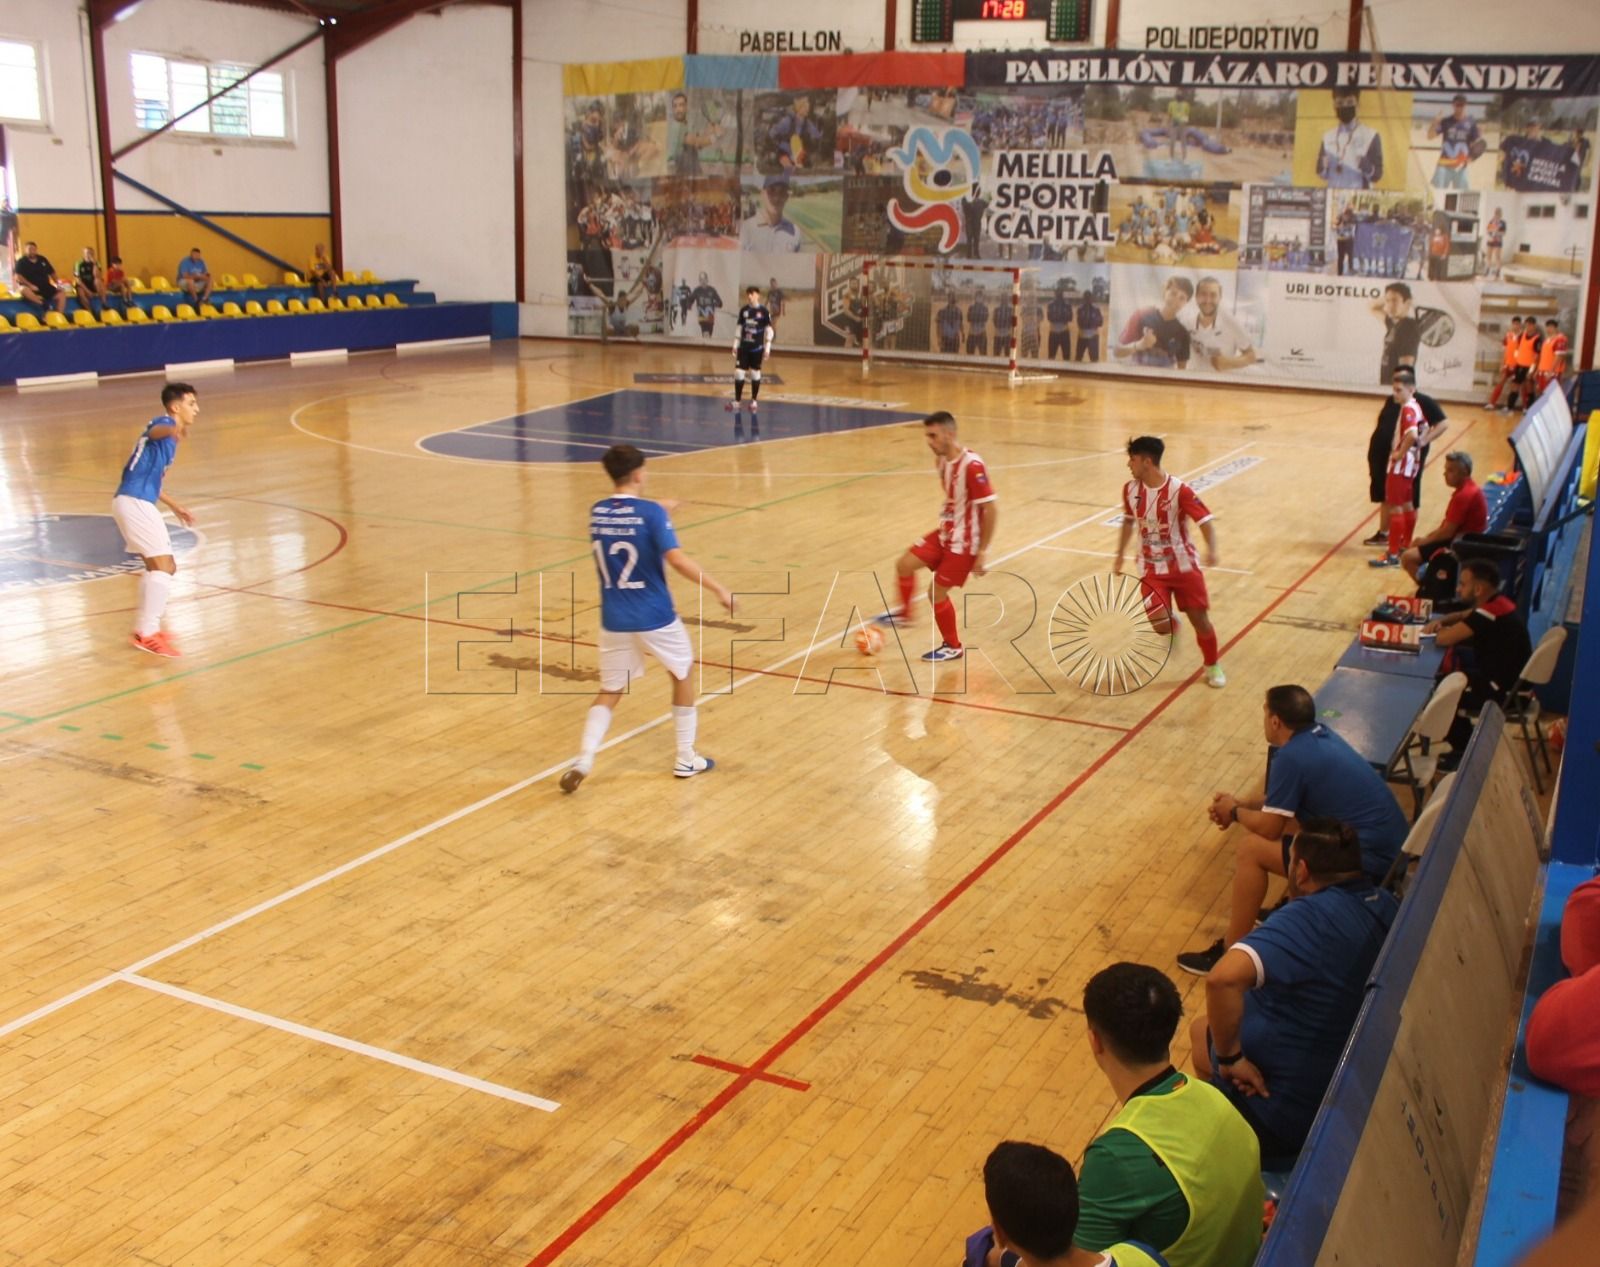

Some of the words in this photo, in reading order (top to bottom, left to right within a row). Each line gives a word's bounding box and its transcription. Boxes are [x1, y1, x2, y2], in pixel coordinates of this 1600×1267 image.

[982, 0, 1024, 19] 17:28
[740, 30, 841, 52] PABELLON
[1146, 26, 1319, 50] POLIDEPORTIVO
[1005, 54, 1174, 84] PABELLÓN
[1181, 55, 1328, 87] LÁZARO
[1336, 58, 1565, 91] FERNÁNDEZ
[996, 153, 1118, 179] MELILLA
[995, 183, 1095, 209] SPORT
[994, 214, 1115, 241] CAPITAL
[1286, 283, 1310, 295] URI
[1314, 284, 1381, 299] BOTELLO
[1134, 496, 1142, 510] 7
[592, 539, 646, 590] 12
